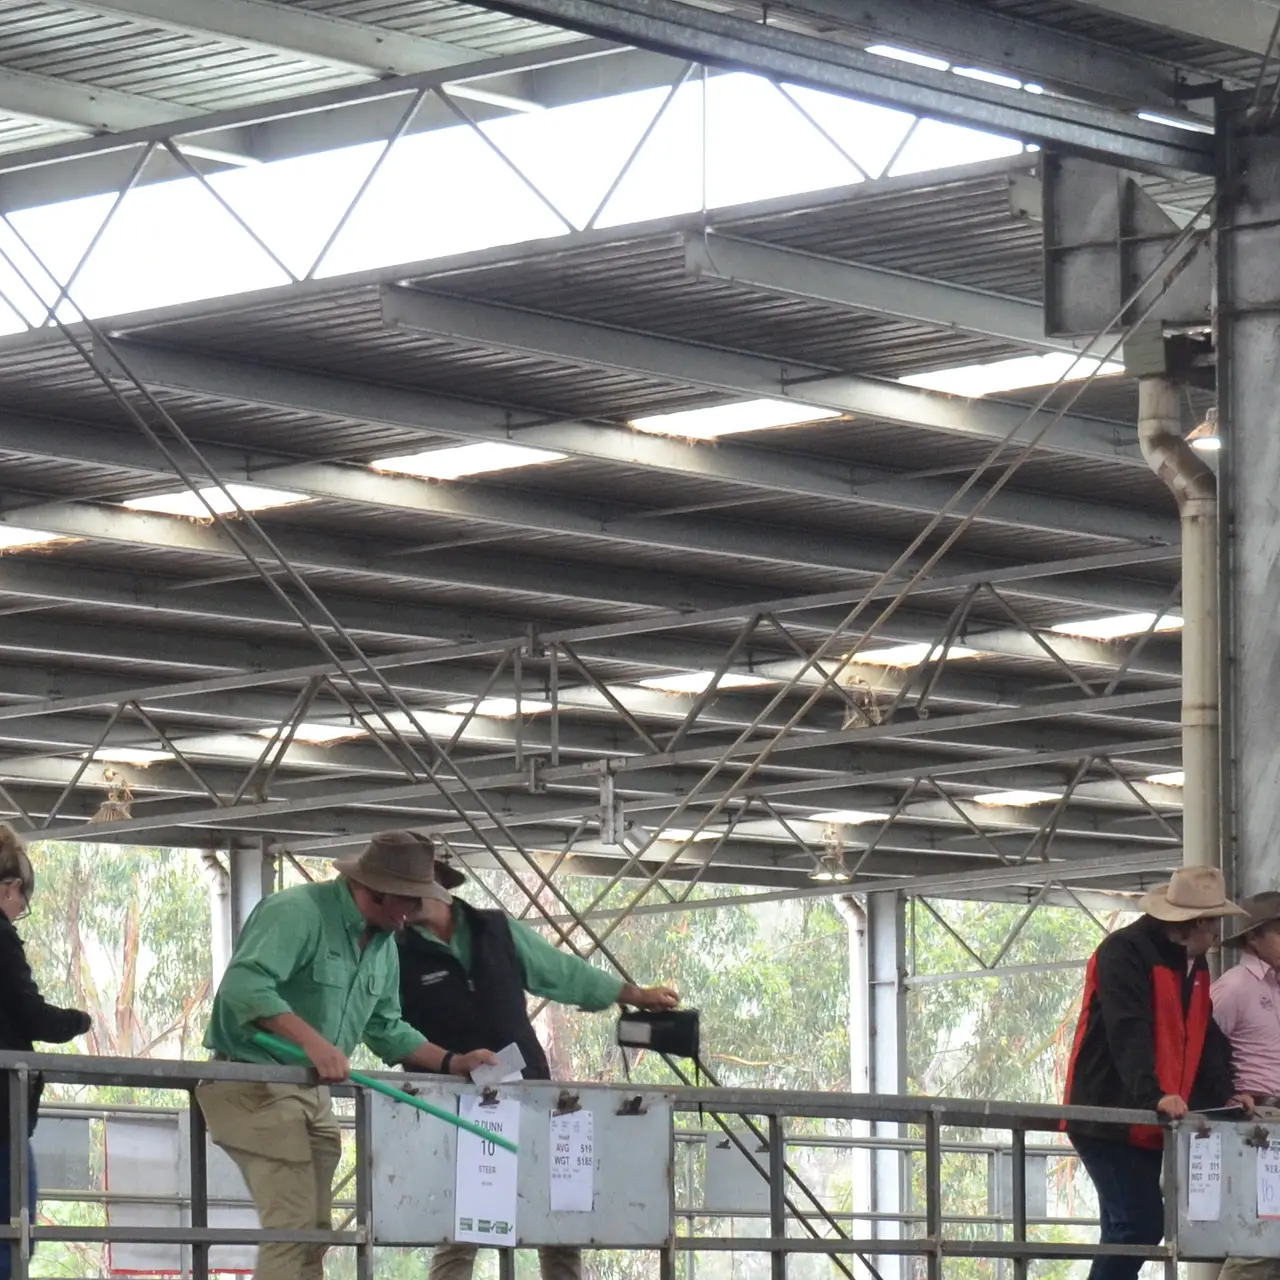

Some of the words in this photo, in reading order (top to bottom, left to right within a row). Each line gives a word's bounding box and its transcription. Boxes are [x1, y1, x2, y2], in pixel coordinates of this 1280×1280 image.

[481, 1139, 495, 1156] 10
[556, 1143, 570, 1153] AVG
[580, 1144, 593, 1154] 519
[554, 1156, 570, 1166] WGT
[577, 1157, 593, 1166] 5185
